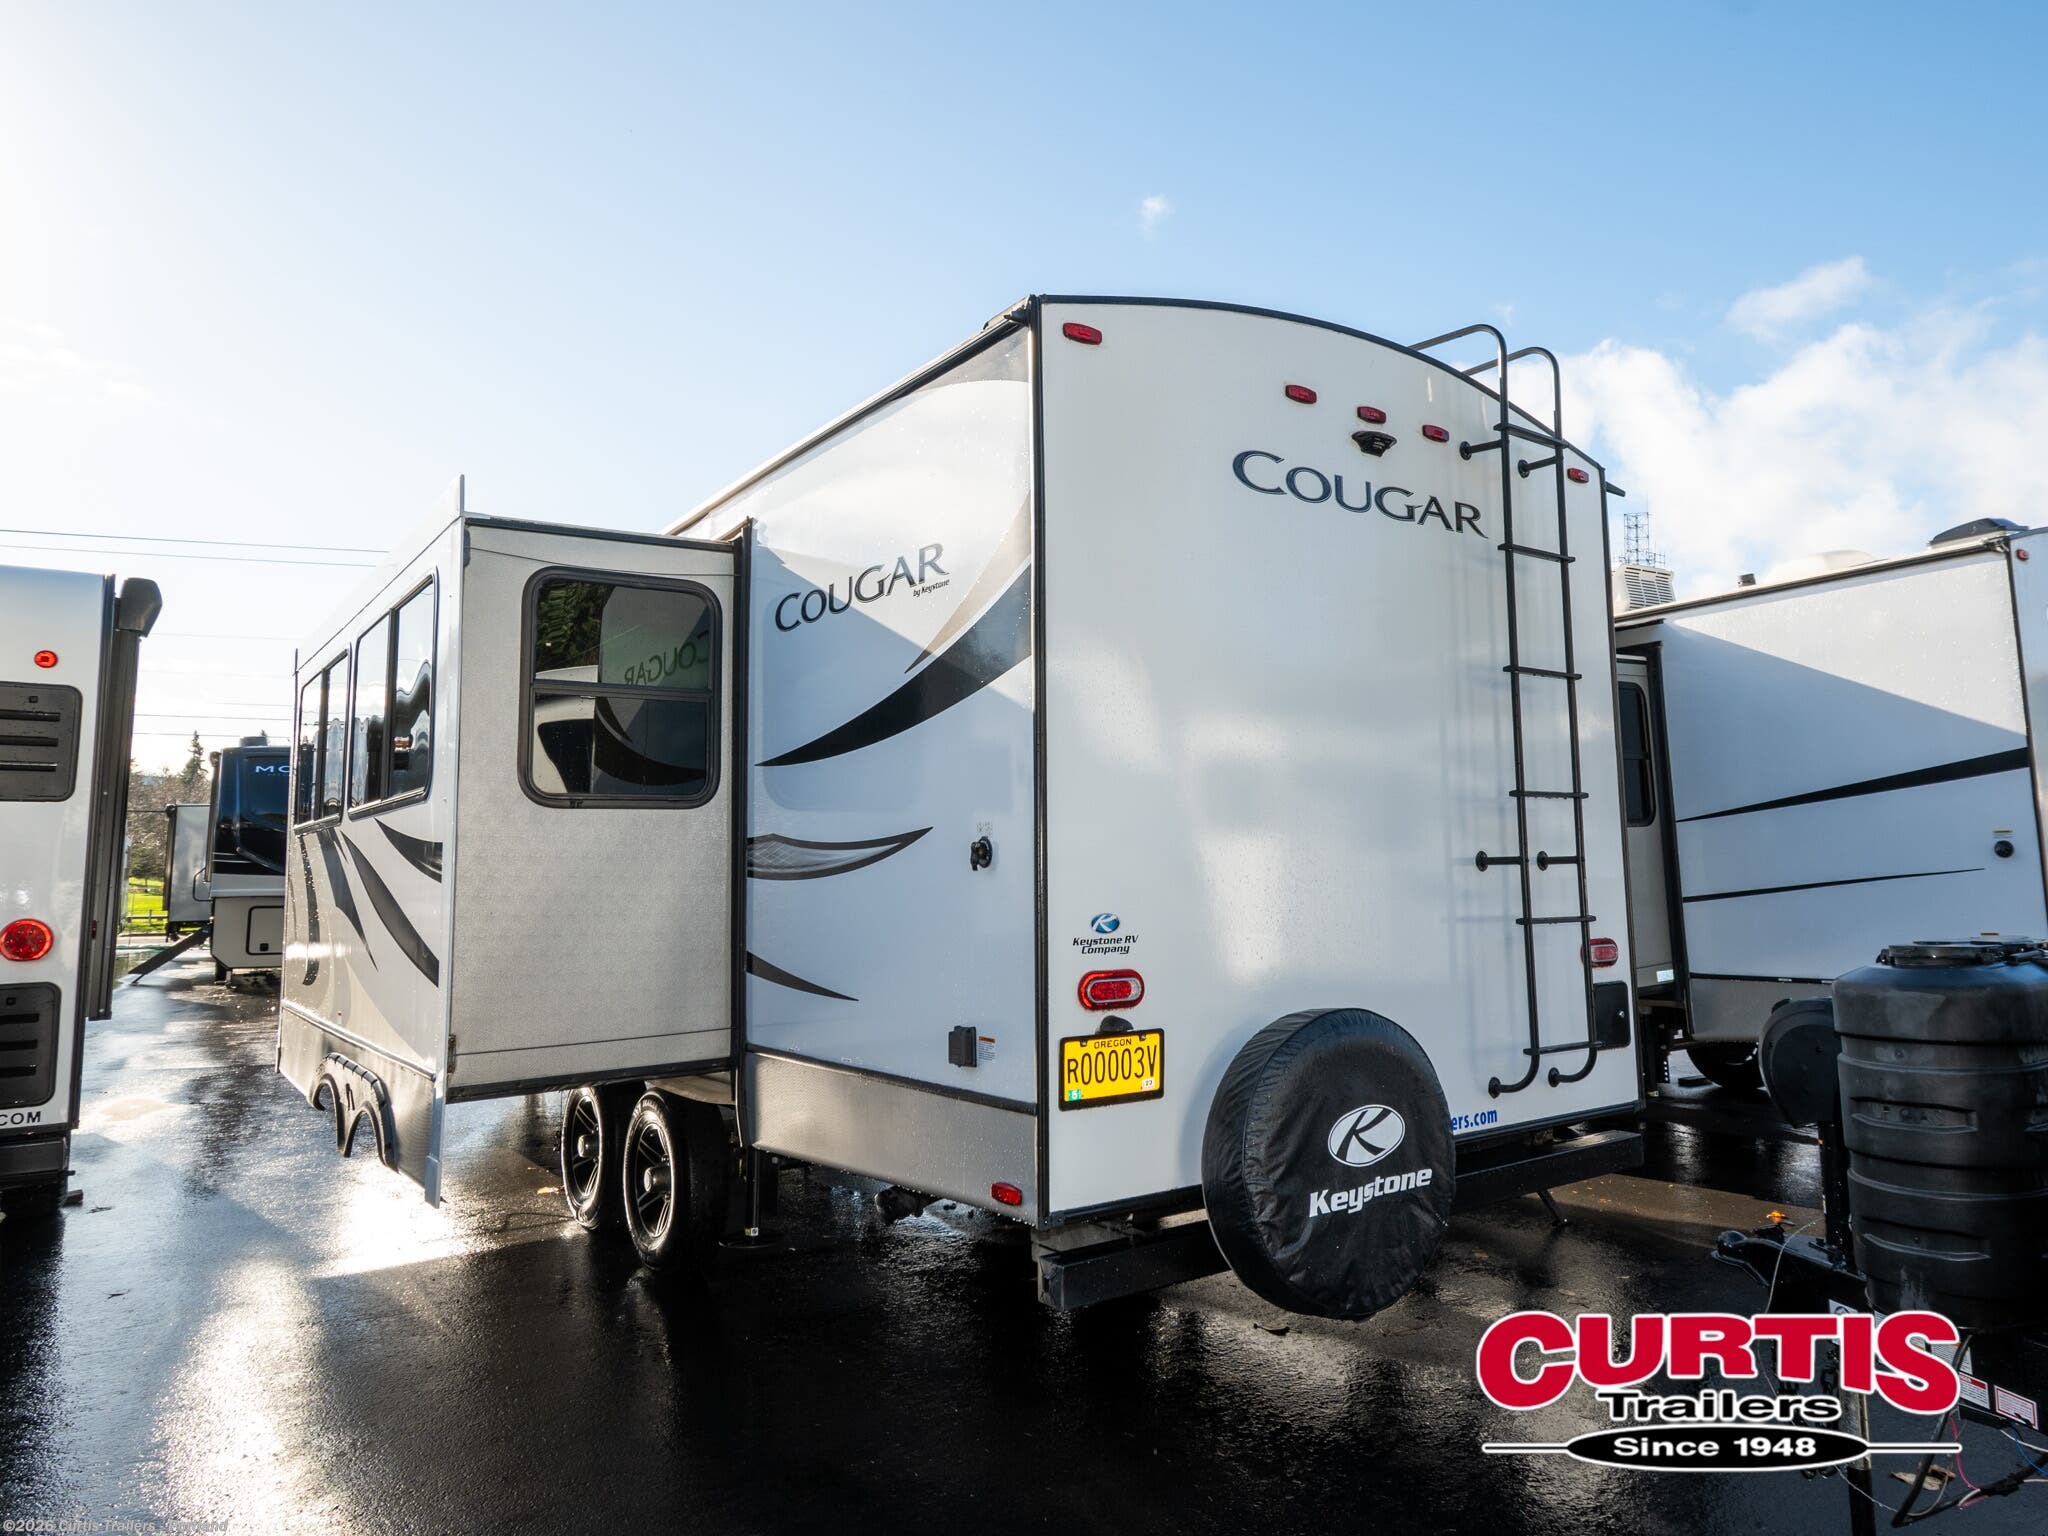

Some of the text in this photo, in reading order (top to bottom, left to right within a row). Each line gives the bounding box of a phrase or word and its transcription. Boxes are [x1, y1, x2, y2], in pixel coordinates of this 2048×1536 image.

[1232, 450, 1489, 539] COUGAR
[775, 543, 950, 632] COUGAR
[1072, 935, 1139, 947] Keystone RV
[1081, 945, 1130, 955] Company
[1094, 1038, 1132, 1049] OREGON
[1067, 1045, 1157, 1085] R00003V
[1309, 1168, 1432, 1217] Keystone
